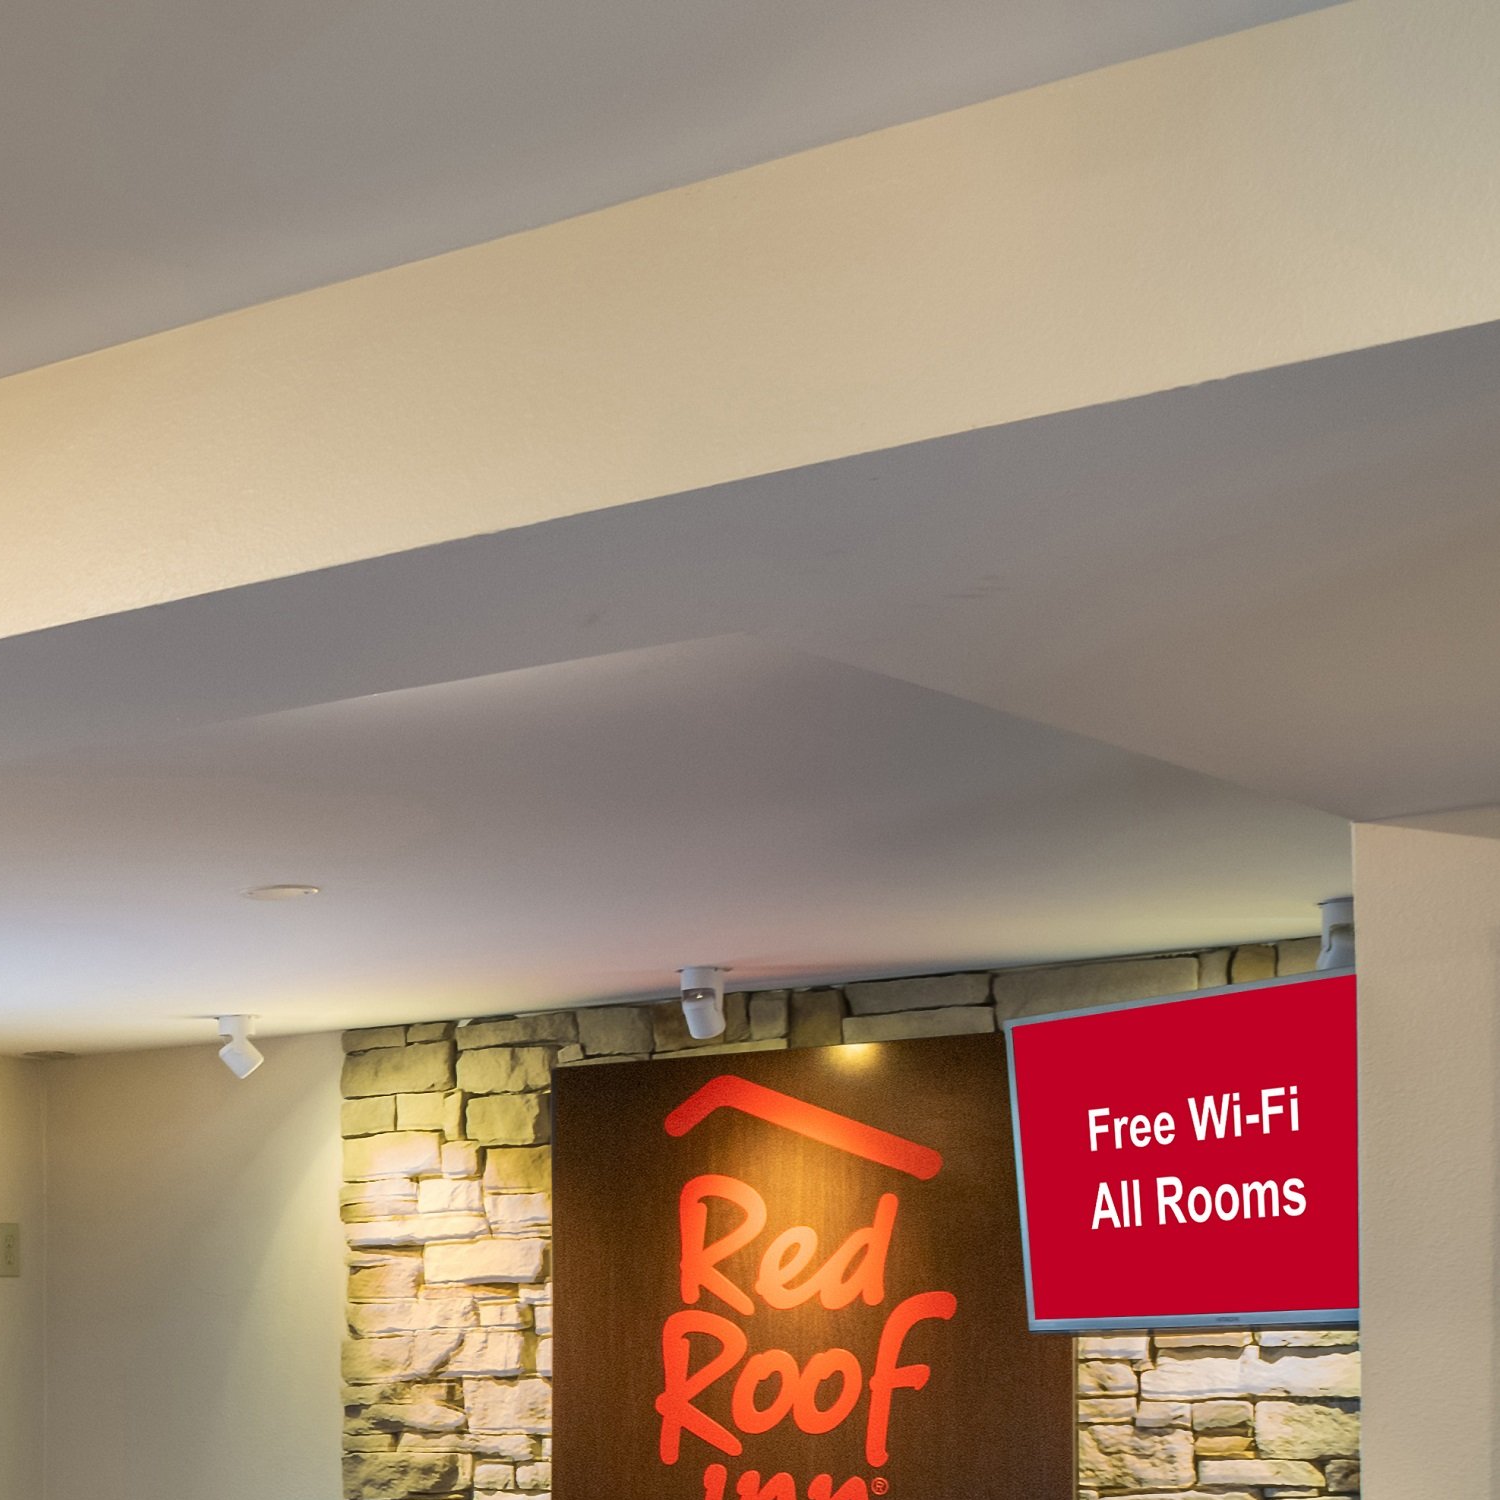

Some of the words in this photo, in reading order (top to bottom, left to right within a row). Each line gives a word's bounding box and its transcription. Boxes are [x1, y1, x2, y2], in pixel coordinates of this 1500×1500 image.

[1088, 1107, 1176, 1152] Free
[1187, 1085, 1300, 1141] Wi-Fi
[679, 1174, 898, 1316] Red
[1091, 1179, 1143, 1230] All
[1156, 1176, 1307, 1225] Rooms
[655, 1291, 957, 1468] Roof
